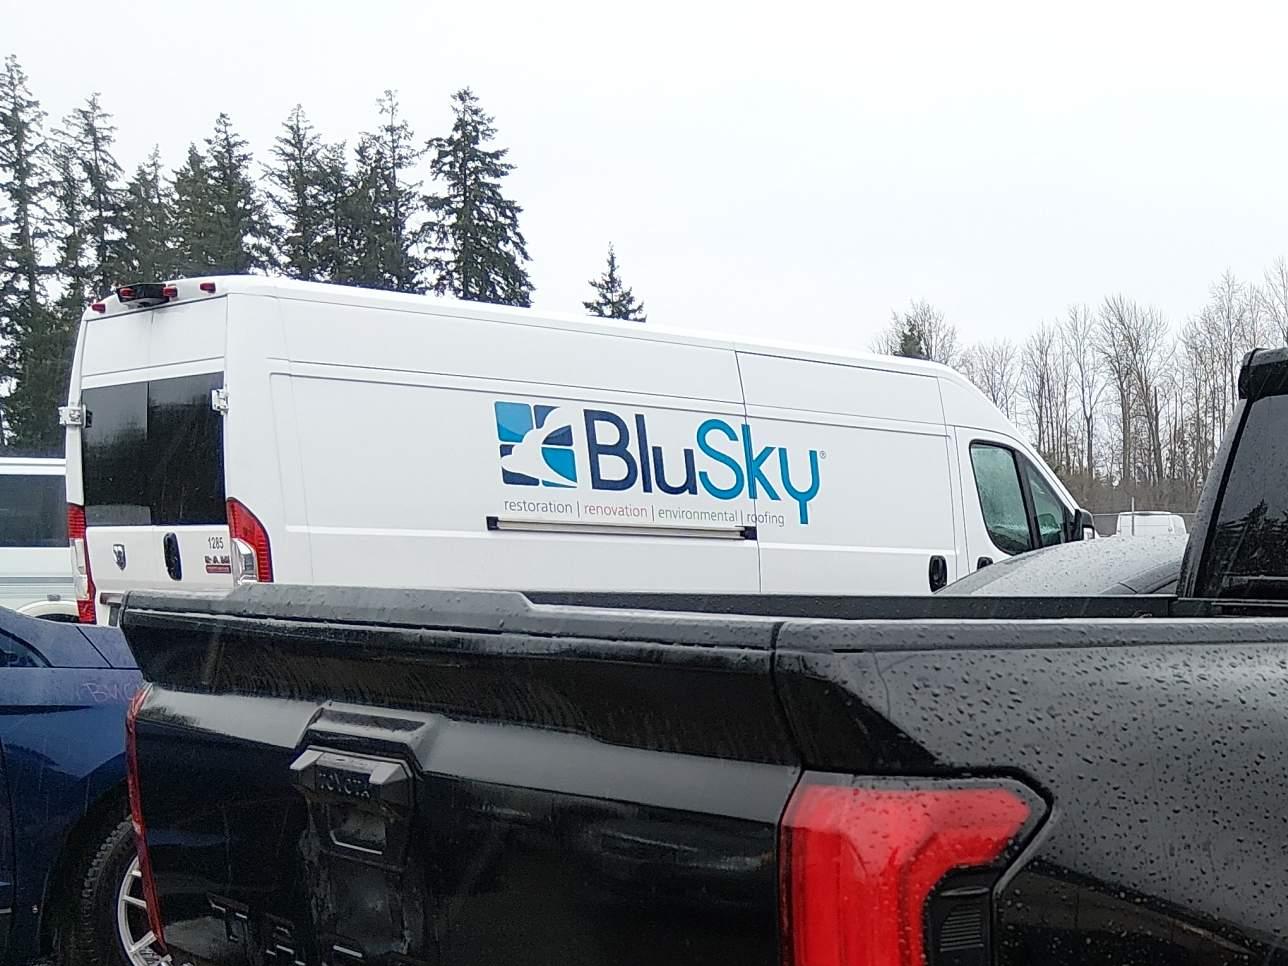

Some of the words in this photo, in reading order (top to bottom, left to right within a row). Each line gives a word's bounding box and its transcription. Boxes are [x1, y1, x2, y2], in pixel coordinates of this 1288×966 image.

[504, 500, 573, 514] restoration
[584, 503, 648, 518] renovation
[658, 507, 738, 522] environmental
[747, 511, 785, 528] roofing
[208, 536, 224, 550] 1285
